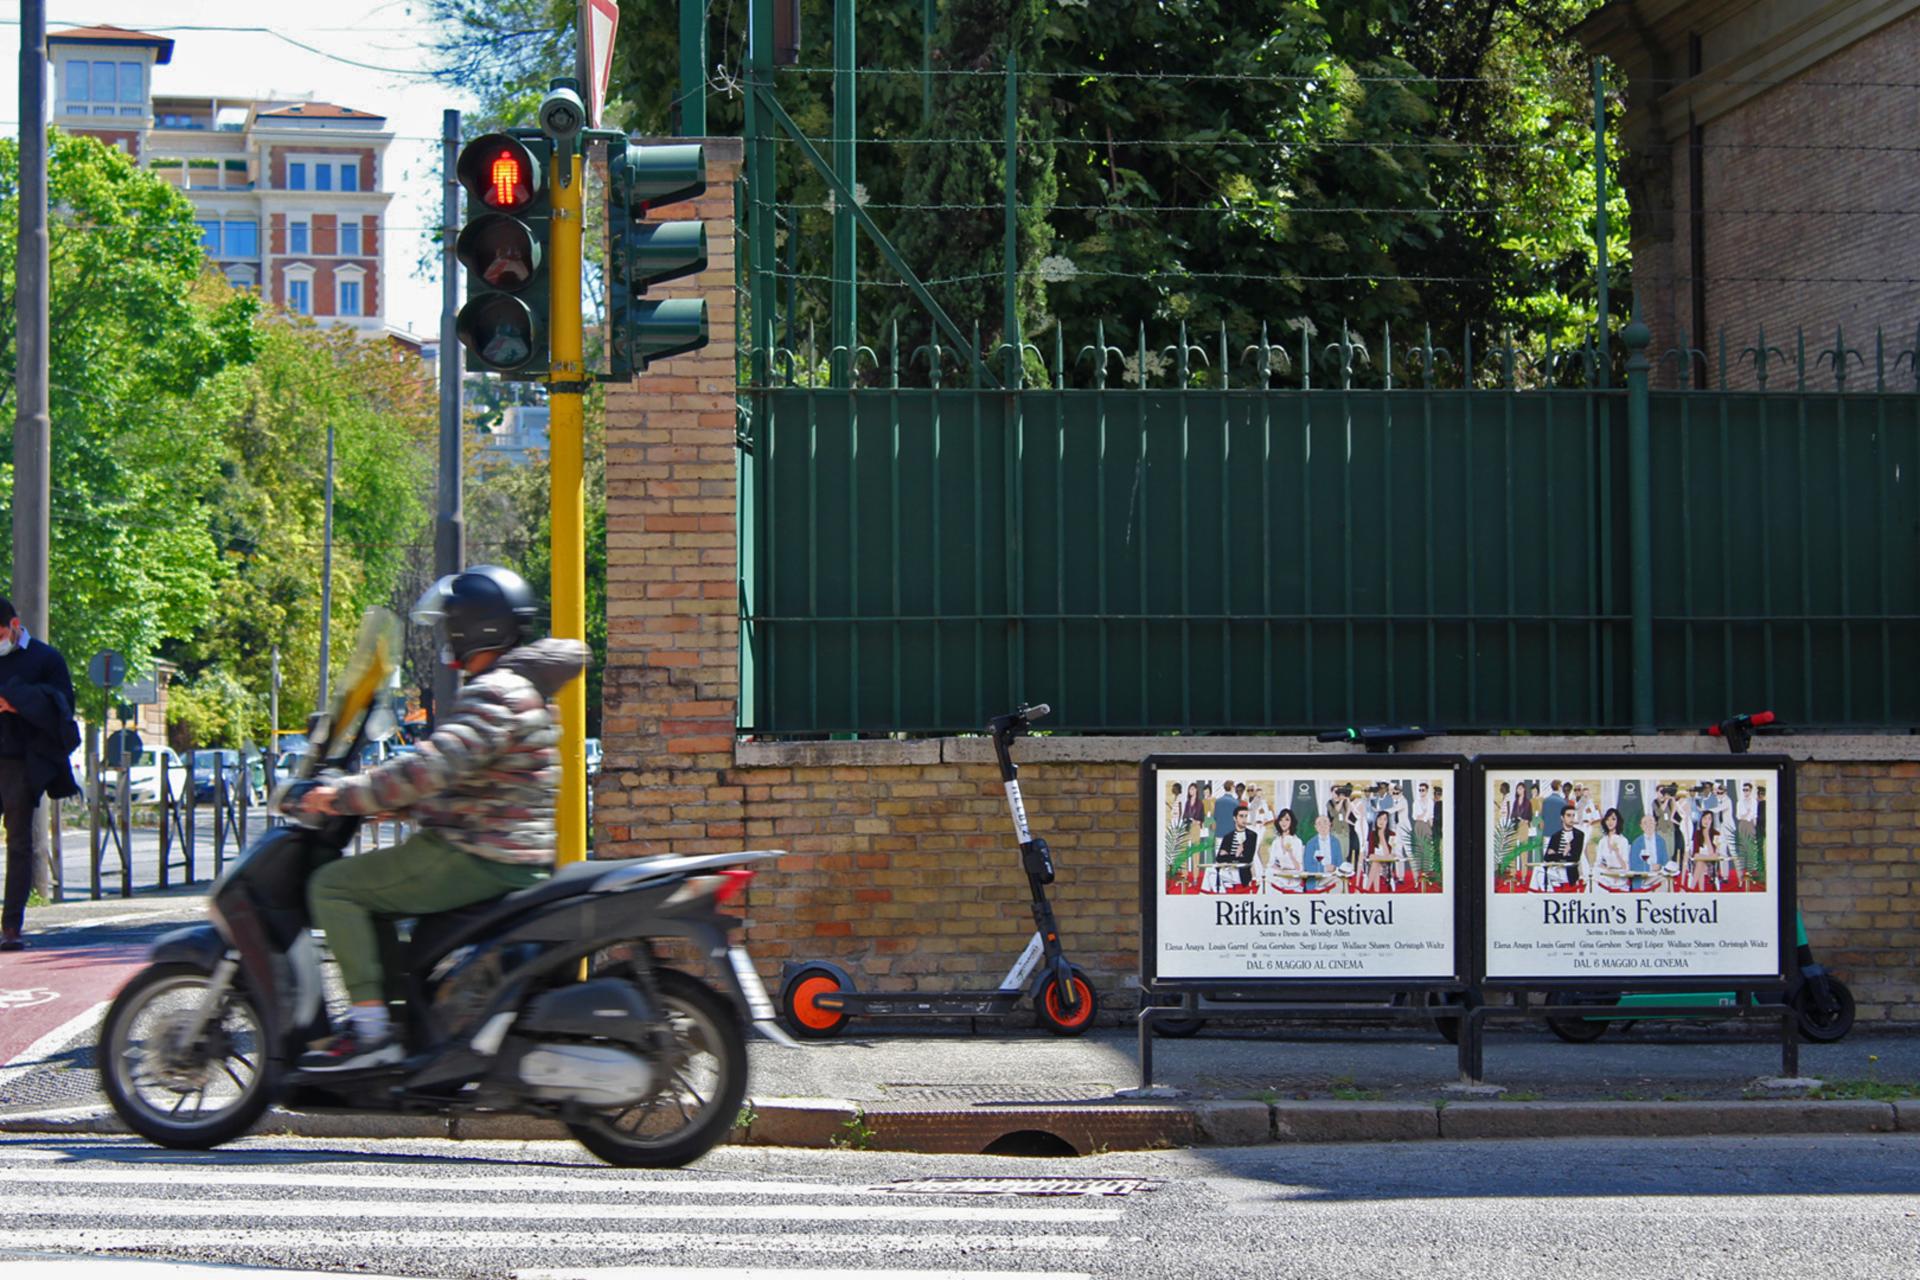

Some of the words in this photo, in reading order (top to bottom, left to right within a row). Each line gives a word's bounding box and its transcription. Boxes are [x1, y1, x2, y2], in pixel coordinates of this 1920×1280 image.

[1215, 900, 1301, 926] Rifkin's
[1309, 899, 1394, 926] Festival
[1543, 899, 1627, 925] Rifkin's
[1635, 898, 1718, 925] Festival
[1309, 928, 1333, 938] Woody
[1332, 928, 1351, 938] Allen
[1635, 927, 1658, 937] Woody
[1658, 927, 1676, 936] Allen
[1164, 942, 1184, 951] Elena
[1208, 942, 1227, 951] Louis
[1251, 941, 1268, 950] Gina
[1268, 941, 1296, 950] Gershon
[1299, 941, 1318, 951] Sergi
[1341, 941, 1368, 950] Wallace
[1368, 941, 1391, 950] Shawn
[1393, 940, 1425, 951] Christoph
[1425, 940, 1445, 950] Waltz
[1578, 940, 1595, 949] Gina
[1595, 940, 1622, 949] Gershon
[1246, 960, 1265, 971] DAL
[1266, 960, 1274, 970] 6
[1274, 959, 1312, 970] MAGGIO
[1313, 959, 1327, 970] AL
[1327, 959, 1364, 970] CINEMA
[1573, 958, 1592, 969] DAL
[1593, 958, 1601, 969] 6
[1601, 958, 1639, 968] MAGGIO
[1639, 958, 1653, 968] AL
[1653, 958, 1689, 968] CINEMA
